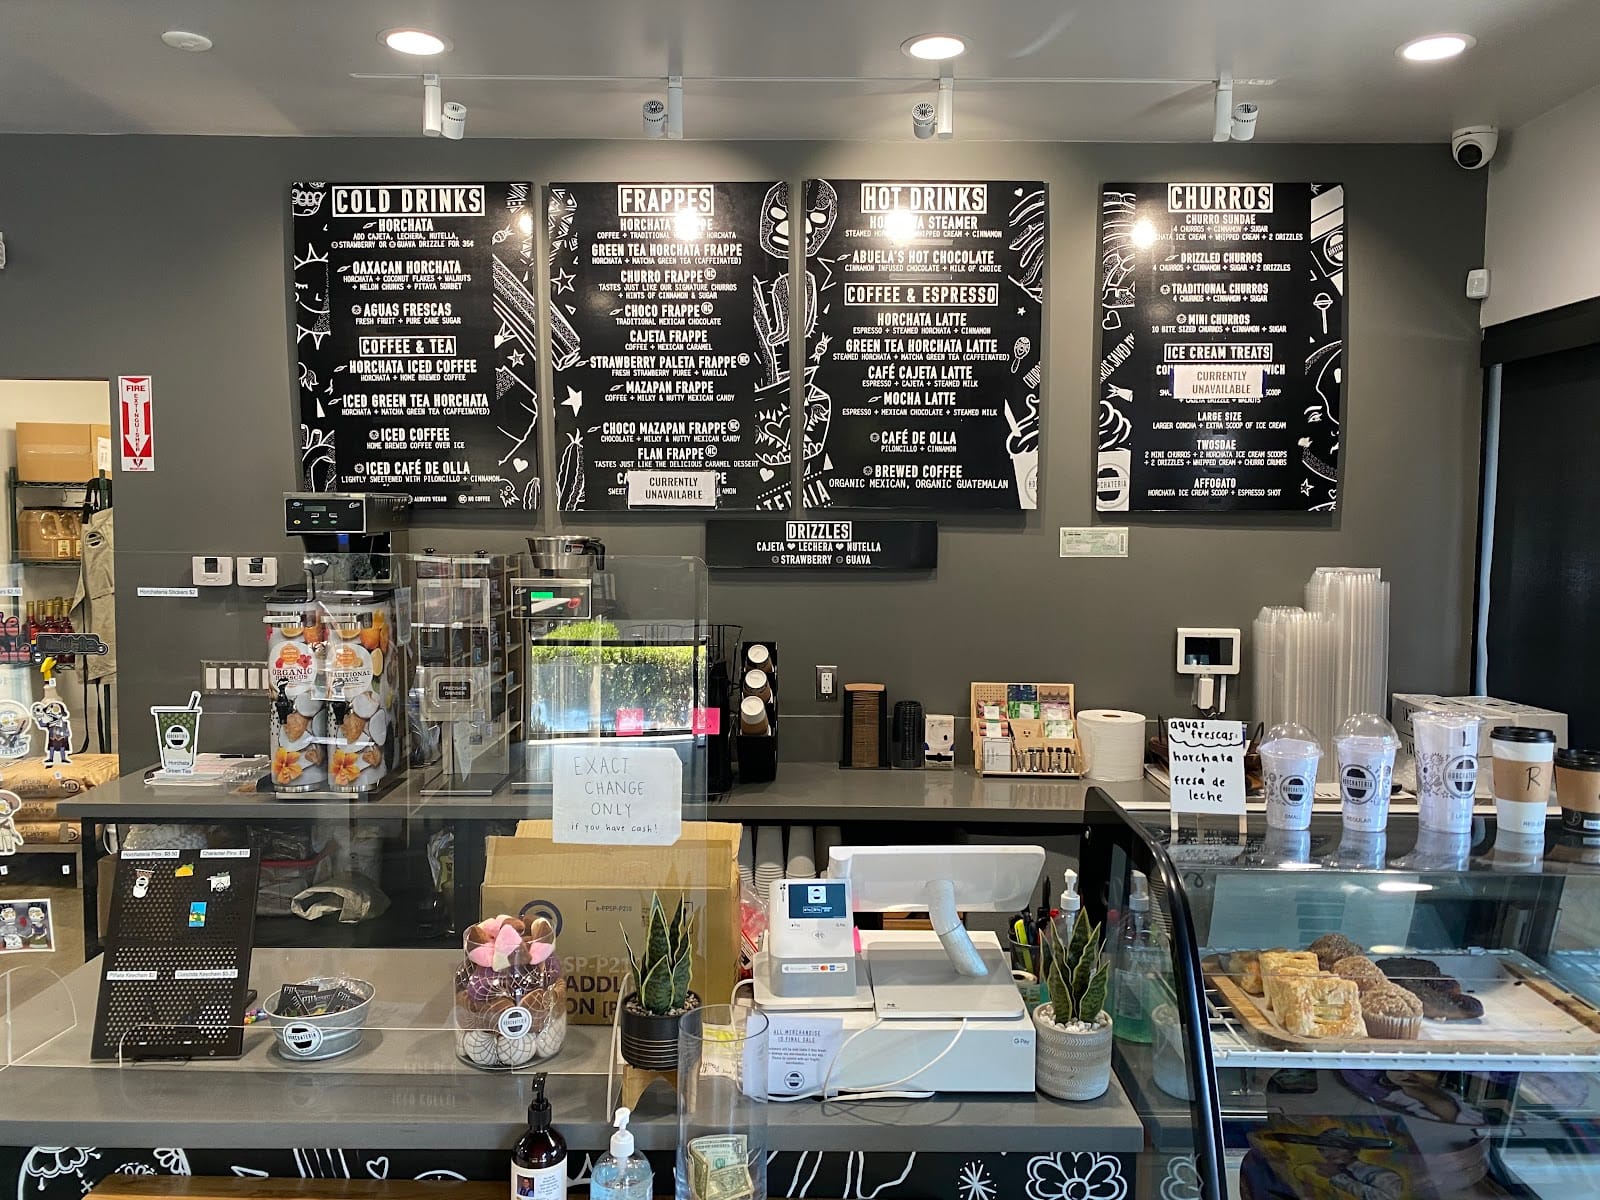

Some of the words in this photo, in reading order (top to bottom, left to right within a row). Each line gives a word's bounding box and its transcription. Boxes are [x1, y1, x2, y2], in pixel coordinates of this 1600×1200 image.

[336, 189, 390, 213] COLD
[404, 189, 481, 213] DRINKS
[622, 190, 711, 212] FRAPPES
[865, 187, 901, 211] HOT
[910, 187, 984, 211] DRINKS
[1170, 186, 1271, 210] CHURROS
[379, 218, 433, 232] HORCHATA
[620, 218, 670, 231] HORCHATA
[928, 216, 978, 230] STEAMER
[1185, 214, 1220, 225] CHURRO
[1222, 214, 1256, 225] SUNDAE
[592, 244, 624, 256] GREEN
[628, 243, 646, 256] TEA
[650, 244, 700, 257] HORCHATA
[704, 244, 743, 257] FRAPPE
[852, 251, 904, 264] ABUELA'S
[908, 251, 930, 264] HOT
[933, 250, 994, 264] CHOCOLATE
[353, 261, 402, 274] OAXACAN
[406, 260, 461, 274] HORCHATA
[620, 270, 661, 283] CHURRO
[664, 270, 703, 283] FRAPPE
[847, 287, 900, 303] COFFEE
[907, 288, 916, 303] &
[922, 286, 996, 303] ESPRESSO
[1171, 283, 1226, 295] TRADITIONAL
[1229, 283, 1269, 295] CHURROS
[364, 303, 399, 316] AGUAS
[403, 303, 451, 316] FRESCAS
[624, 304, 658, 318] CHOCO
[661, 304, 700, 318] FRAPPE
[878, 312, 931, 326] HORCHATA
[936, 313, 966, 326] LATTE
[1189, 314, 1207, 324] MINI
[1211, 314, 1250, 324] CHURROS
[630, 330, 665, 342] CAJETA
[669, 330, 707, 344] FRAPPE
[362, 339, 411, 354] COFFEE
[416, 340, 424, 353] &
[430, 339, 453, 354] TEA
[845, 339, 880, 354] GREEN
[884, 339, 904, 354] TEA
[908, 339, 962, 354] HORCHATA
[966, 339, 997, 352] LATTE
[1167, 346, 1186, 360] ICE
[1189, 346, 1226, 360] CREAM
[1230, 346, 1271, 360] TREATS
[350, 360, 404, 373] HORCHATA
[408, 360, 432, 373] ICED
[436, 360, 477, 373] COFFEE
[590, 356, 657, 370] STRAWBERRY
[660, 356, 695, 370] PALETA
[699, 356, 736, 370] FRAPPE
[868, 363, 895, 379] CAFÉ
[899, 366, 937, 379] CAJETA
[941, 366, 972, 379] LATTE
[1196, 371, 1247, 381] CURRENTLY
[626, 381, 672, 393] MAZAPAN
[676, 381, 713, 393] FRAPPE
[1192, 384, 1251, 394] UNAVAILABLE
[343, 394, 367, 407] ICED
[372, 394, 406, 407] GREEN
[410, 394, 430, 407] TEA
[434, 394, 488, 407] HORCHATA
[884, 392, 921, 405] MOCHA
[925, 392, 956, 405] LATTE
[1198, 412, 1222, 421] LARGE
[1225, 412, 1241, 421] SIZE
[381, 428, 405, 441] ICED
[410, 428, 449, 441] COFFEE
[603, 422, 635, 436] CHOCO
[640, 422, 686, 436] MAZAPAN
[689, 422, 726, 436] FRAPPE
[882, 429, 908, 444] CAFÉ
[912, 432, 925, 444] DE
[930, 432, 956, 444] OLLA
[638, 448, 662, 460] FLAN
[667, 448, 704, 459] FRAPPE
[366, 462, 390, 475] ICED
[395, 459, 421, 475] CAFÉ
[425, 462, 439, 474] DE
[443, 461, 470, 474] OLLA
[875, 465, 918, 477] BREWED
[923, 465, 962, 478] COFFEE
[649, 477, 698, 486] CURRENTLY
[829, 479, 864, 488] ORGANIC
[870, 479, 909, 489] MEXICAN,
[916, 479, 951, 488] ORGANIC
[957, 479, 1008, 488] GUATEMALAN
[1194, 478, 1236, 490] AFFOGATO
[645, 490, 703, 499] UNAVAILABLE
[788, 523, 849, 539] DRIZZLES
[756, 541, 785, 552] CAJETA
[798, 541, 833, 552] LECHERA
[846, 541, 881, 552] NUTELLA
[780, 555, 832, 565] STRAWBERRY
[845, 555, 871, 565] GUAVA
[272, 668, 313, 677] ORGANIC
[1170, 721, 1205, 733] aguas
[1462, 730, 1471, 747] L
[1173, 751, 1233, 763] horchata
[574, 756, 629, 776] EXACT
[1174, 775, 1205, 786] fresa
[1212, 777, 1225, 787] de
[1526, 766, 1542, 791] R
[584, 780, 646, 796] CHANGE
[1189, 789, 1223, 802] leche
[590, 802, 632, 818] ONLY
[570, 823, 579, 832] if
[585, 824, 600, 834] you
[605, 822, 625, 832] have
[631, 823, 658, 834] cash!
